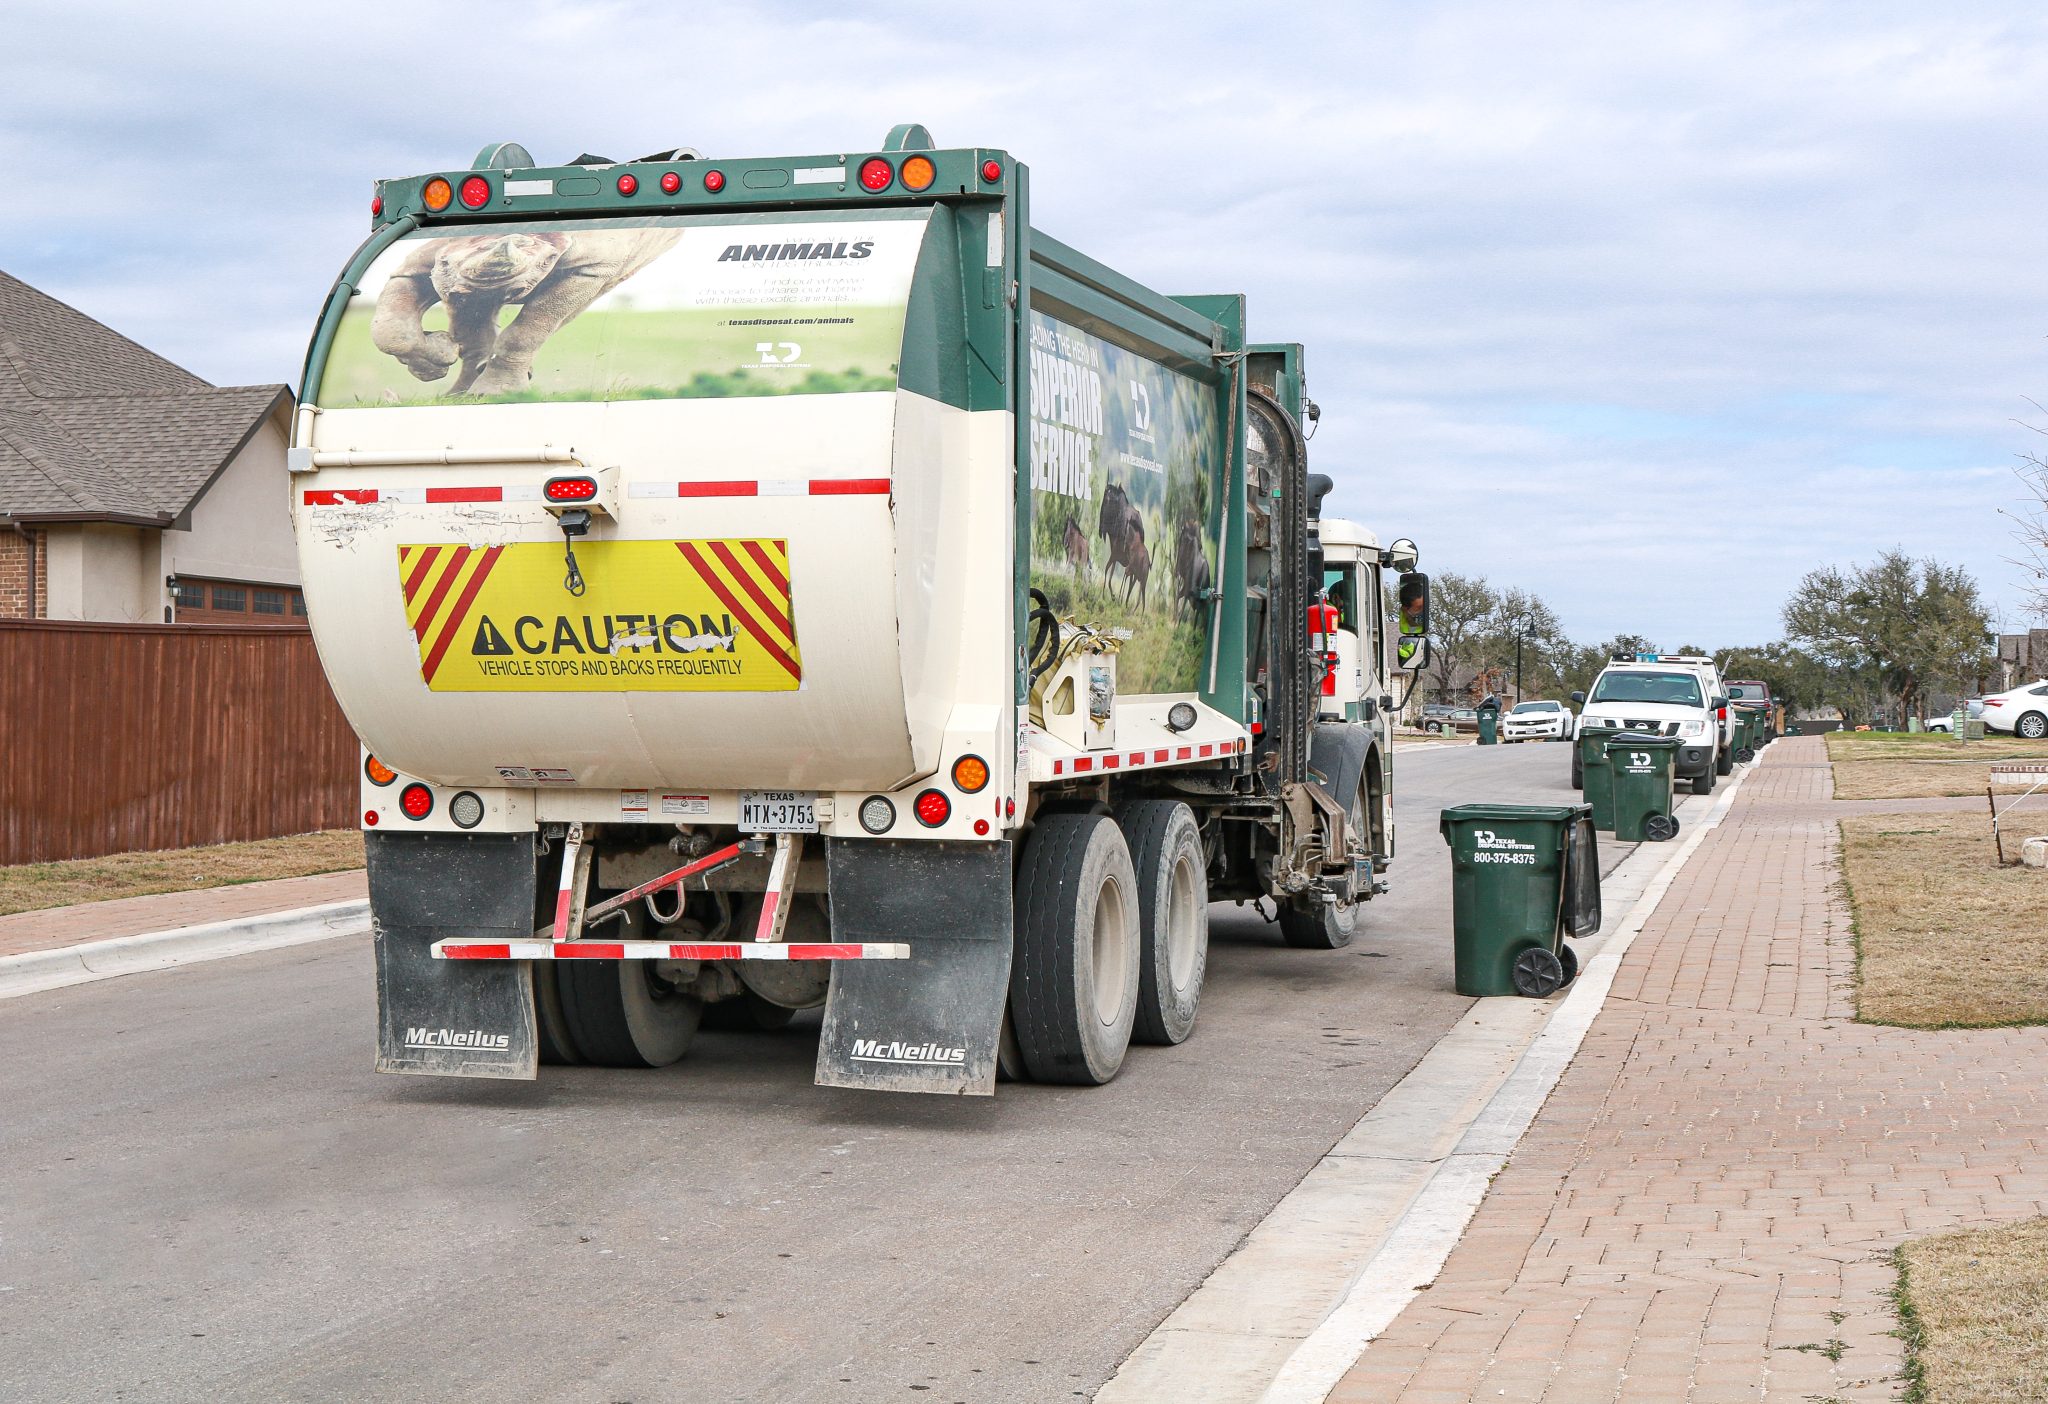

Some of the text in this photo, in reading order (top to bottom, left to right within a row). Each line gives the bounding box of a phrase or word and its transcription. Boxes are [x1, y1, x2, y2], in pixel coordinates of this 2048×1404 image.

[717, 241, 875, 262] ANIMALS
[741, 260, 765, 269] ON
[748, 287, 761, 295] to
[763, 286, 799, 295] share
[763, 277, 791, 286] Find
[793, 278, 814, 286] out
[695, 297, 721, 305] with
[723, 296, 759, 304] these
[760, 294, 798, 304] exotic
[716, 317, 855, 327] at texasdisposal.com/animals
[1055, 333, 1072, 358] THE
[1071, 338, 1090, 364] HERD
[1090, 346, 1099, 368] IN
[1030, 349, 1103, 436] SUPERIOR
[1030, 418, 1092, 500] SERVICE
[514, 613, 736, 655] CAUTION
[478, 659, 742, 676] VEHICLE STOPS AND BACKS FREQUENTLY
[764, 792, 795, 801] TEXAS
[743, 805, 815, 824] MTX 3753
[1473, 852, 1535, 864] 800-375-8375
[404, 1027, 510, 1048] McNeilus
[850, 1039, 966, 1061] McNeilus
